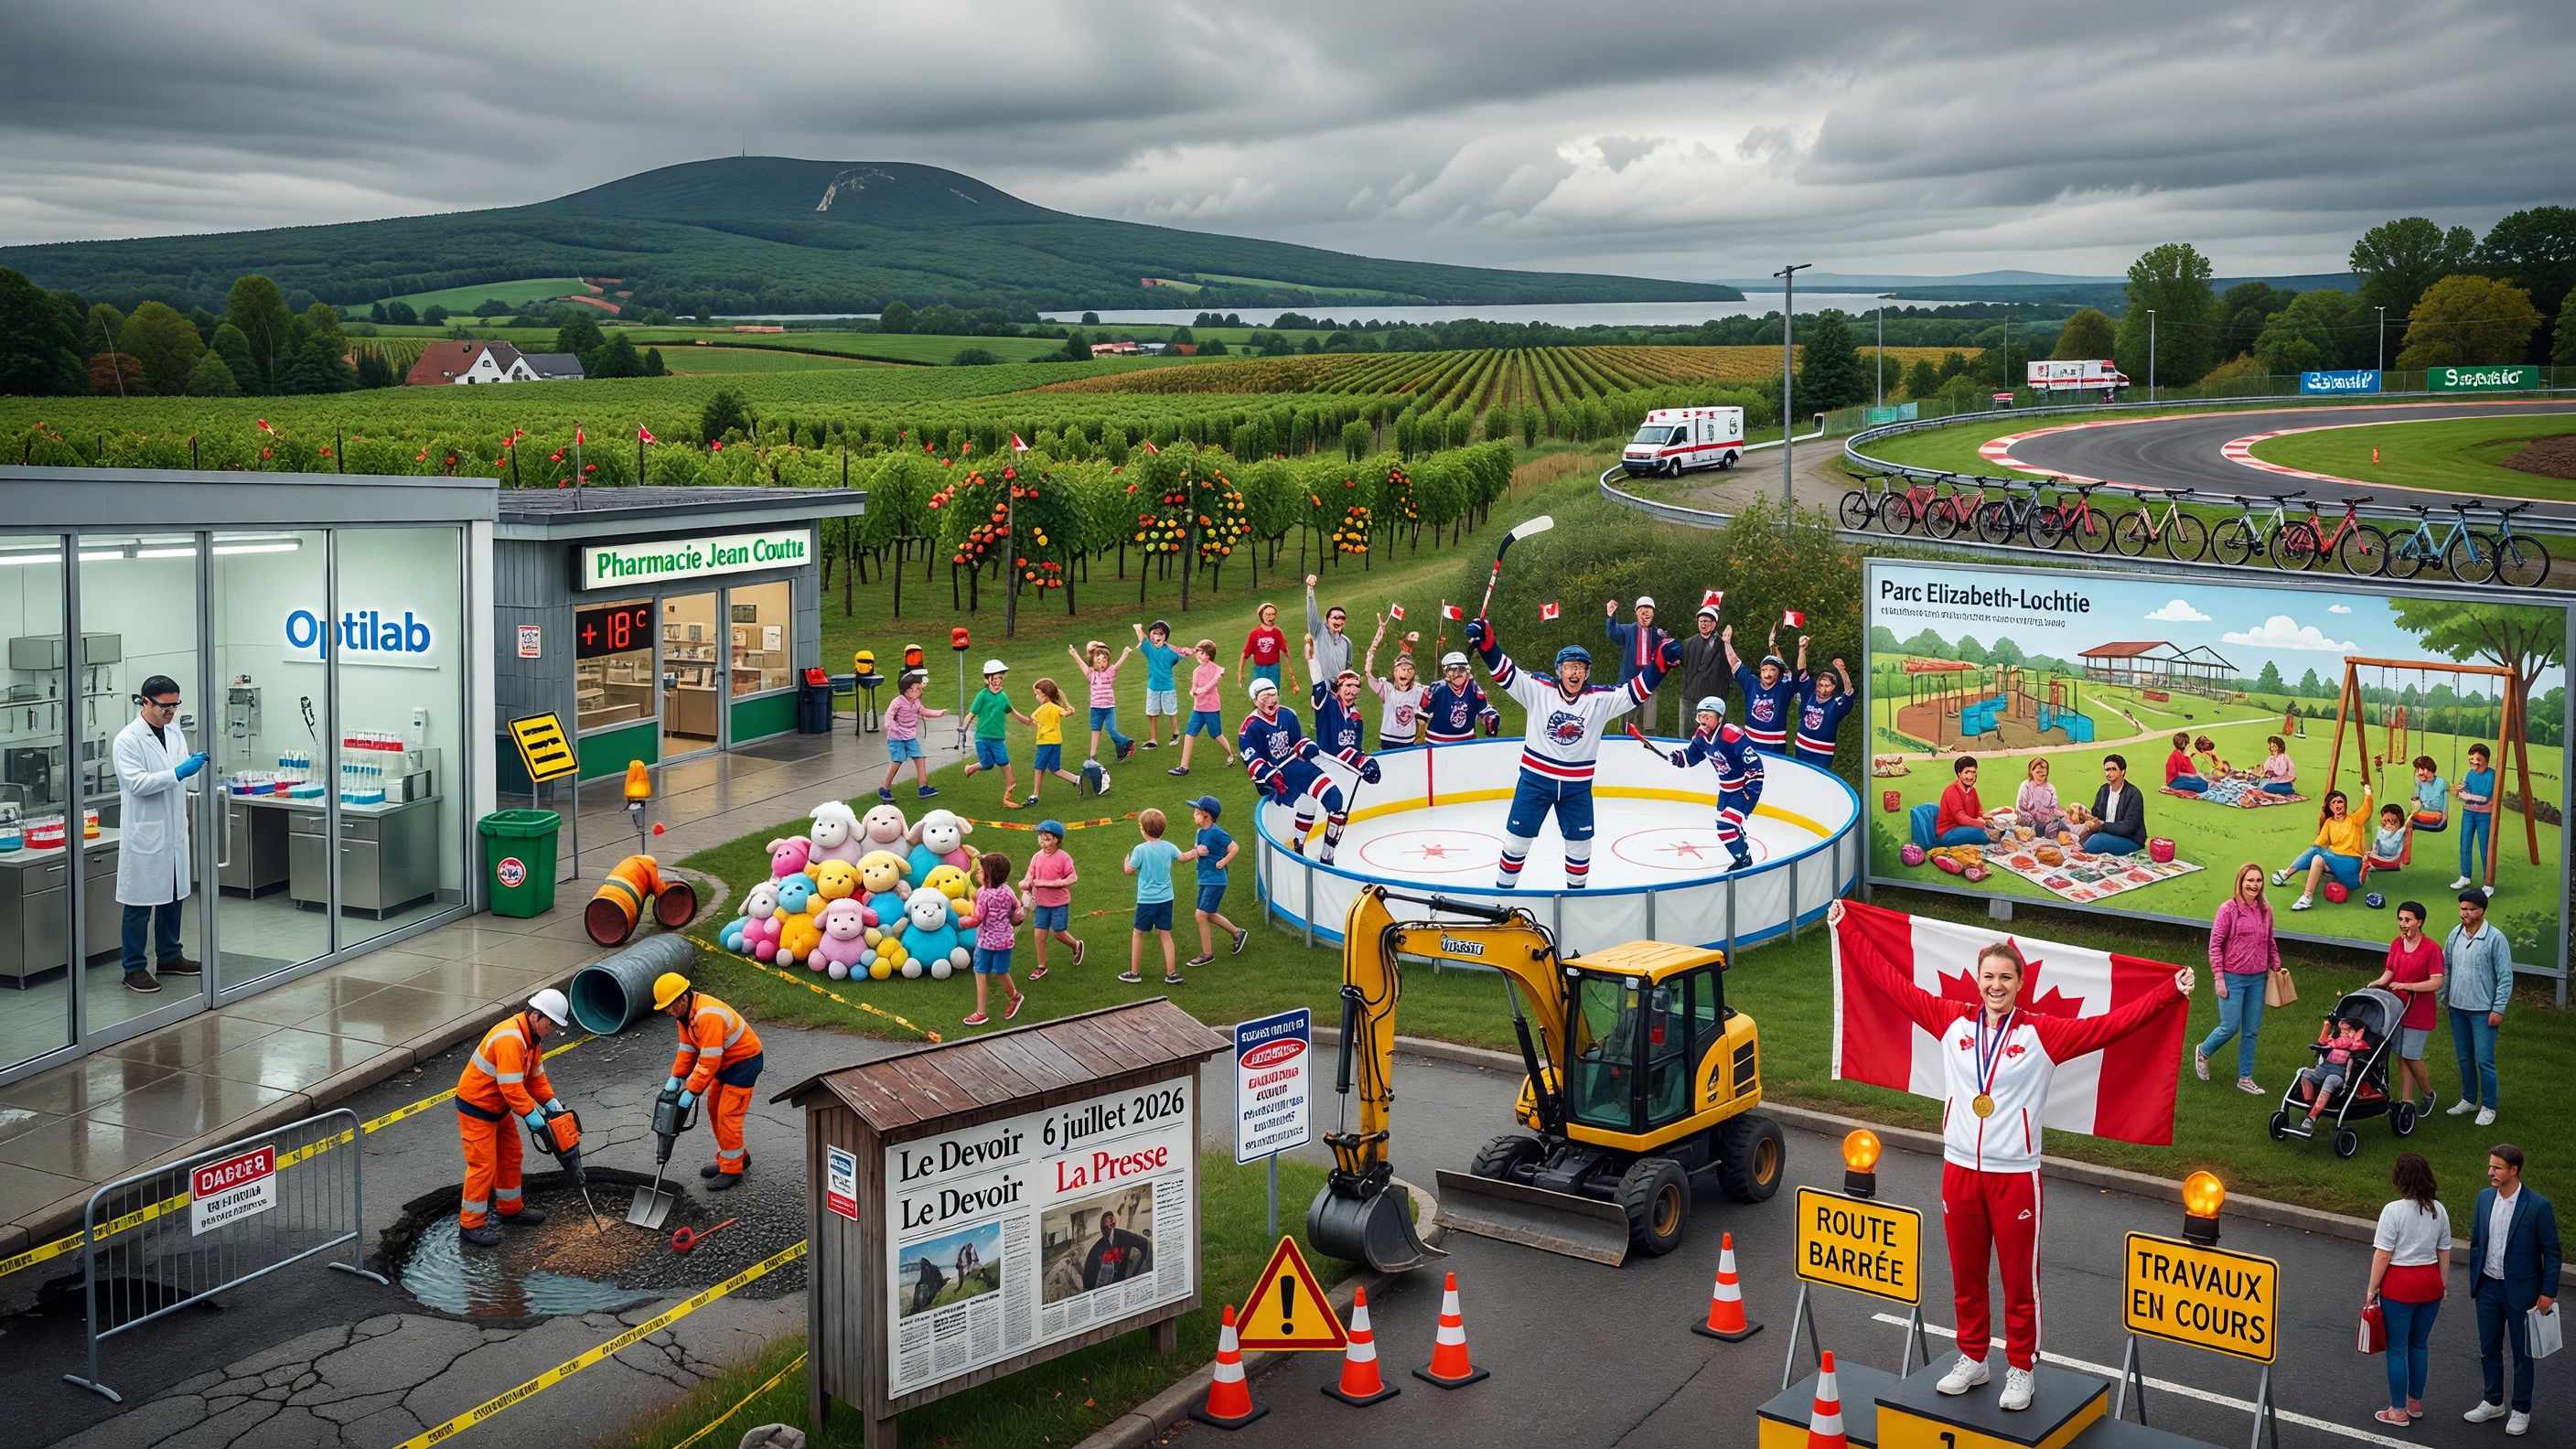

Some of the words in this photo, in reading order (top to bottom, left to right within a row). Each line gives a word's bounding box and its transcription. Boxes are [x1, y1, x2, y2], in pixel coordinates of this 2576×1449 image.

[596, 545, 702, 578] Pharmacie
[706, 543, 749, 568] Jean
[1882, 580, 1922, 602] Parc
[1927, 583, 2090, 613] Elizabeth-Lochtie
[1043, 1117, 1056, 1146] 6
[1061, 1102, 1126, 1151] juillet
[1132, 1087, 1185, 1125] 2026
[899, 1150, 934, 1183] Le
[939, 1128, 1024, 1173] Devoir
[1057, 1161, 1088, 1193] La
[1092, 1146, 1168, 1184] Presse
[901, 1199, 934, 1230] Le
[939, 1175, 1024, 1221] Devoir
[1817, 1207, 1896, 1248] ROUTE
[1809, 1240, 1904, 1286] BARRÉE
[2137, 1250, 2262, 1304] TRAVAUX
[2133, 1288, 2164, 1321] EN
[2175, 1300, 2266, 1345] COURS
